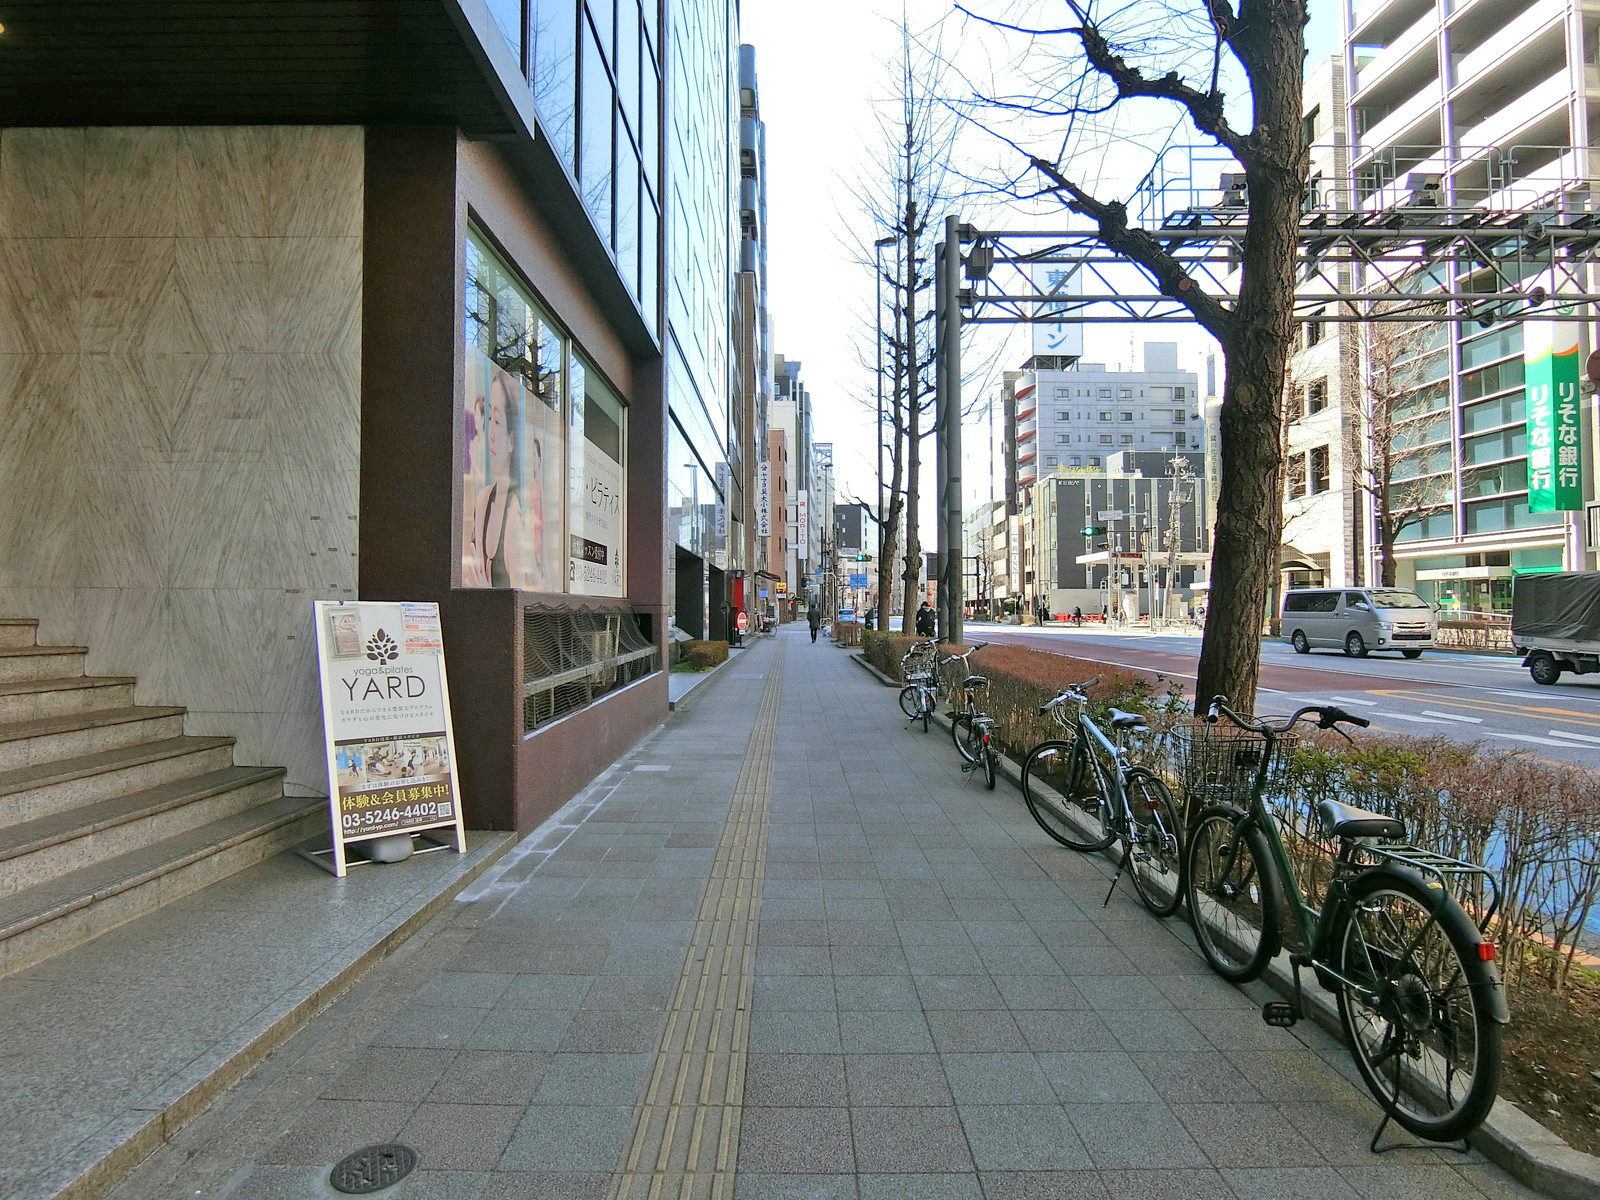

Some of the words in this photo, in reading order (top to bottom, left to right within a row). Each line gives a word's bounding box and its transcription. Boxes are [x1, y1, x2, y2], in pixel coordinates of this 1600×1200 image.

[1530, 384, 1552, 491] りそな銀行
[1557, 382, 1578, 488] りそな銀行
[799, 512, 807, 545] MORITO
[353, 666, 413, 677] yoga&pilates
[342, 675, 426, 701] YARD
[342, 784, 449, 810] 体験&会員募集中!
[343, 802, 436, 828] 03-5246-4402
